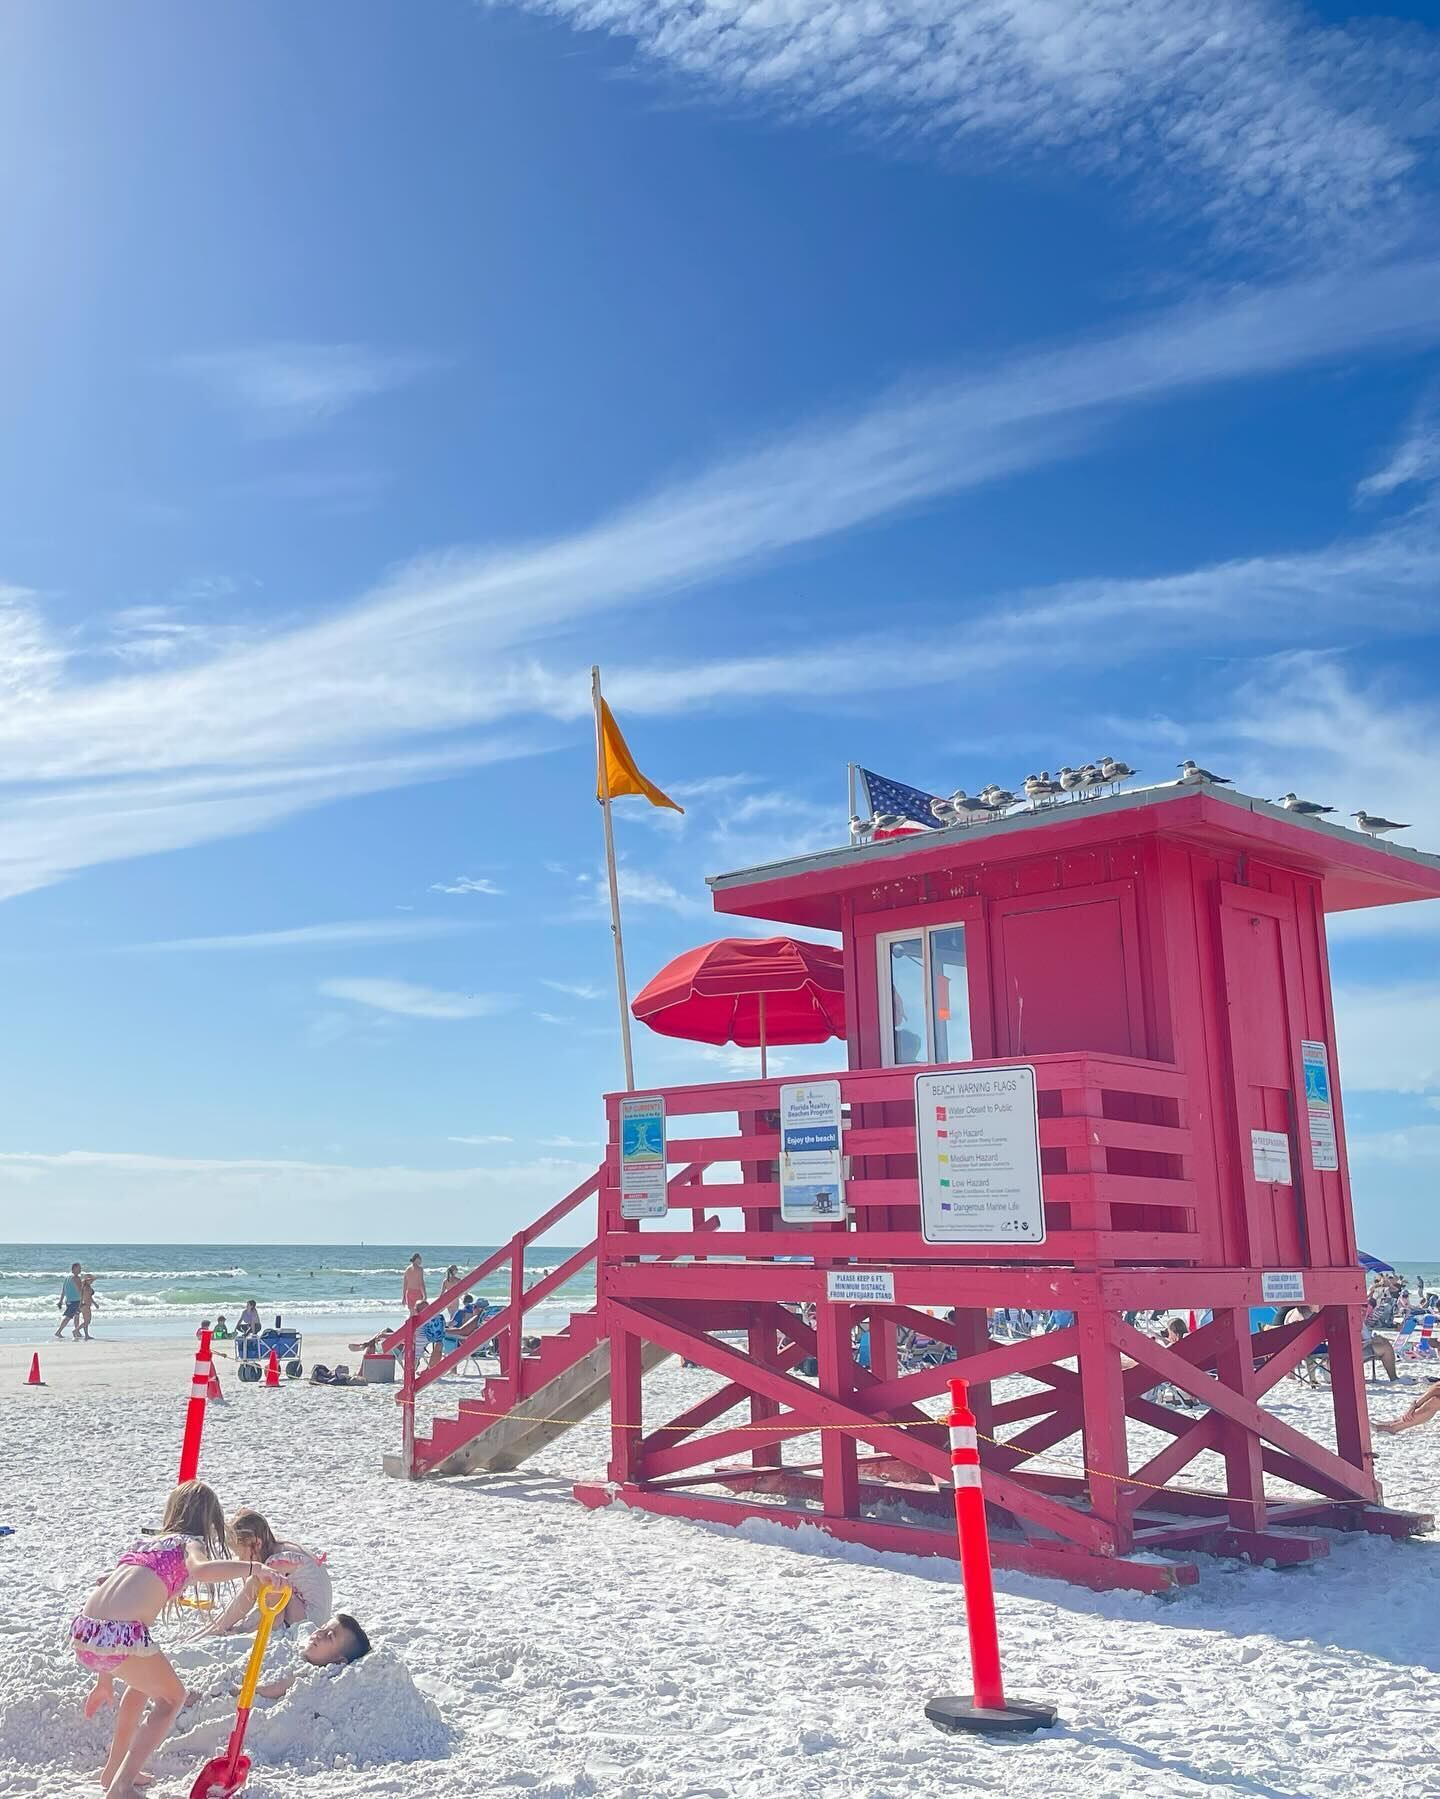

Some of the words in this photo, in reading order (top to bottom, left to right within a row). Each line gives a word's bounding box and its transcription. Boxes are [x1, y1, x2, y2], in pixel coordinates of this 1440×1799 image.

[932, 1085, 955, 1096] BEACH
[958, 1082, 990, 1094] WARNING
[994, 1080, 1017, 1091] FLAGS
[949, 1106, 965, 1114] Water
[966, 1105, 986, 1114] Closed
[994, 1103, 1013, 1112] Public
[949, 1129, 962, 1139] High
[963, 1128, 984, 1136] Hazard
[787, 1136, 804, 1145] Enjoy
[804, 1135, 815, 1143] the
[815, 1134, 836, 1142] beach!
[950, 1153, 975, 1162] Medium
[976, 1152, 999, 1161] Hazard
[966, 1179, 990, 1187] Hazard
[953, 1202, 985, 1213] Dangerous
[986, 1202, 1007, 1211] Marine
[1008, 1201, 1020, 1211] Life
